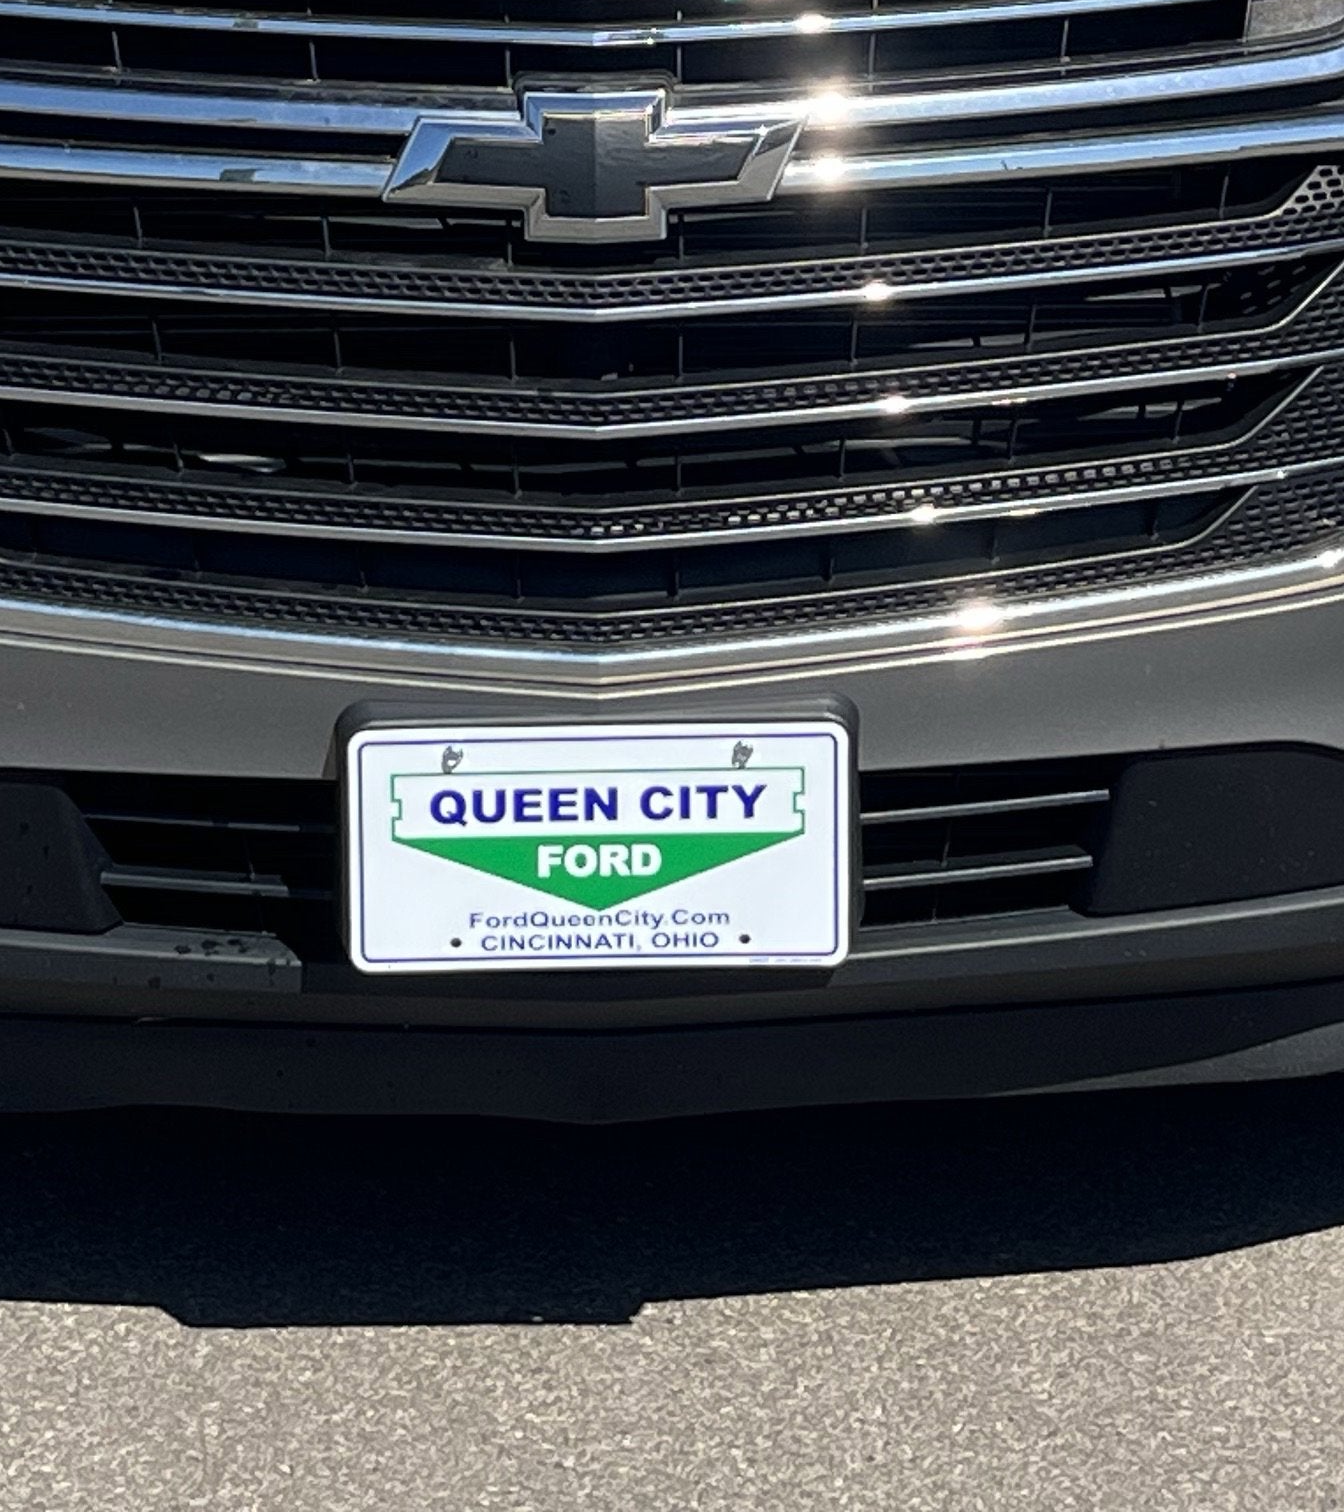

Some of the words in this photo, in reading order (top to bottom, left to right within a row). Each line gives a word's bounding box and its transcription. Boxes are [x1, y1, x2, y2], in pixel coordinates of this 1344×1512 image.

[429, 787, 618, 826] QUEEN
[639, 784, 767, 821] CITY
[537, 843, 662, 878] FORD
[468, 908, 731, 929] FordQueenCity.Com
[480, 932, 643, 952] CINCINNATI,
[651, 931, 720, 949] OHIO
